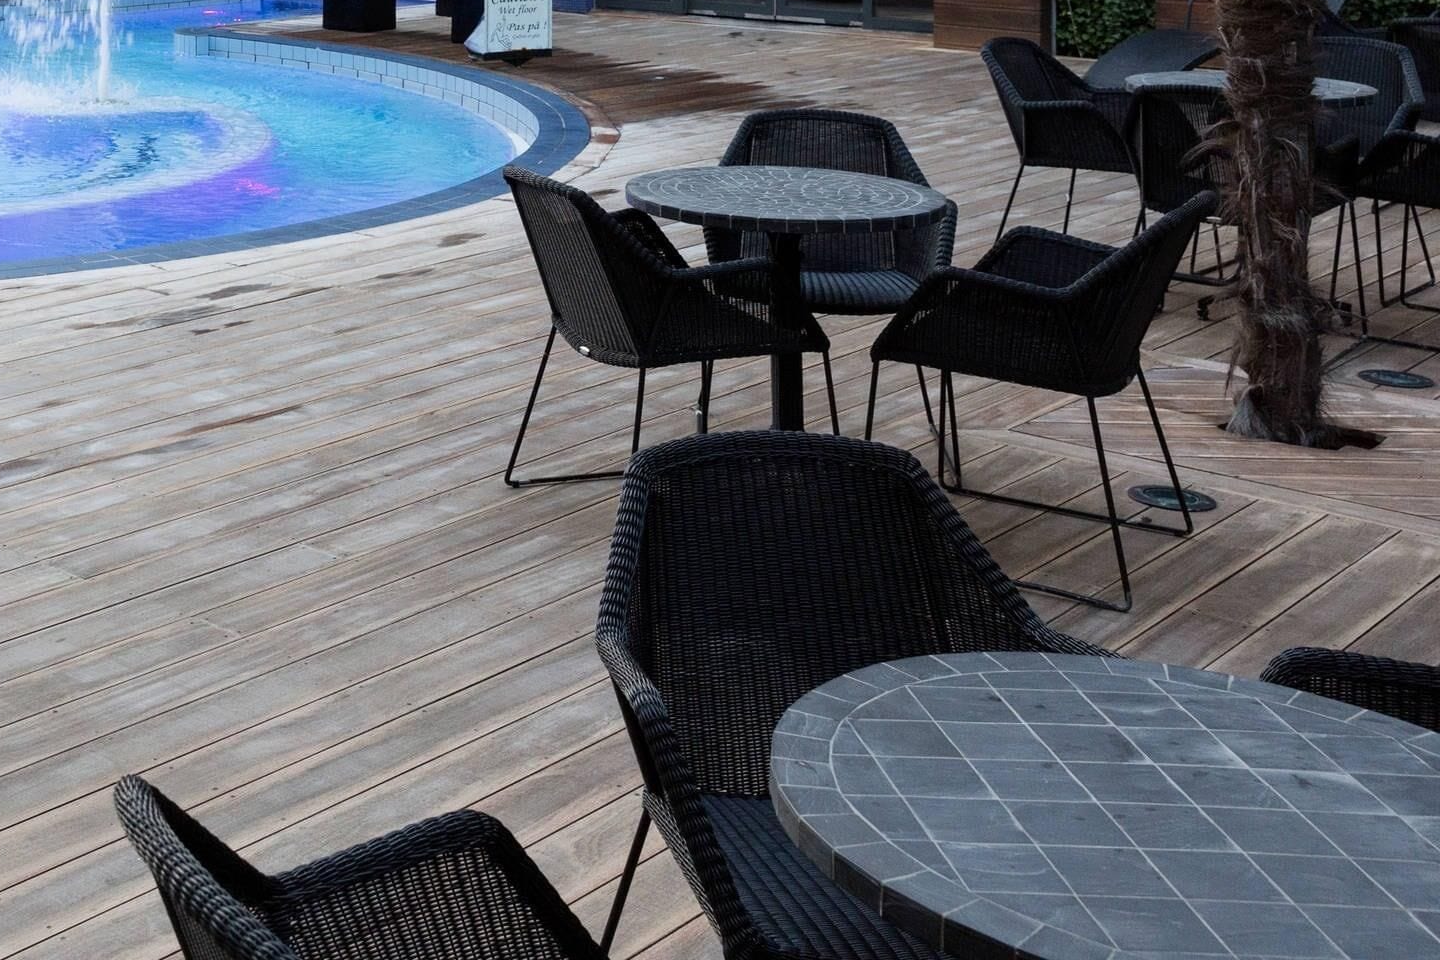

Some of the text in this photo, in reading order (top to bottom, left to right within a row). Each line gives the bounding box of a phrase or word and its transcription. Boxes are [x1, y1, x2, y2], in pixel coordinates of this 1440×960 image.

[499, 4, 538, 17] Wet floor
[507, 22, 525, 31] Pas
